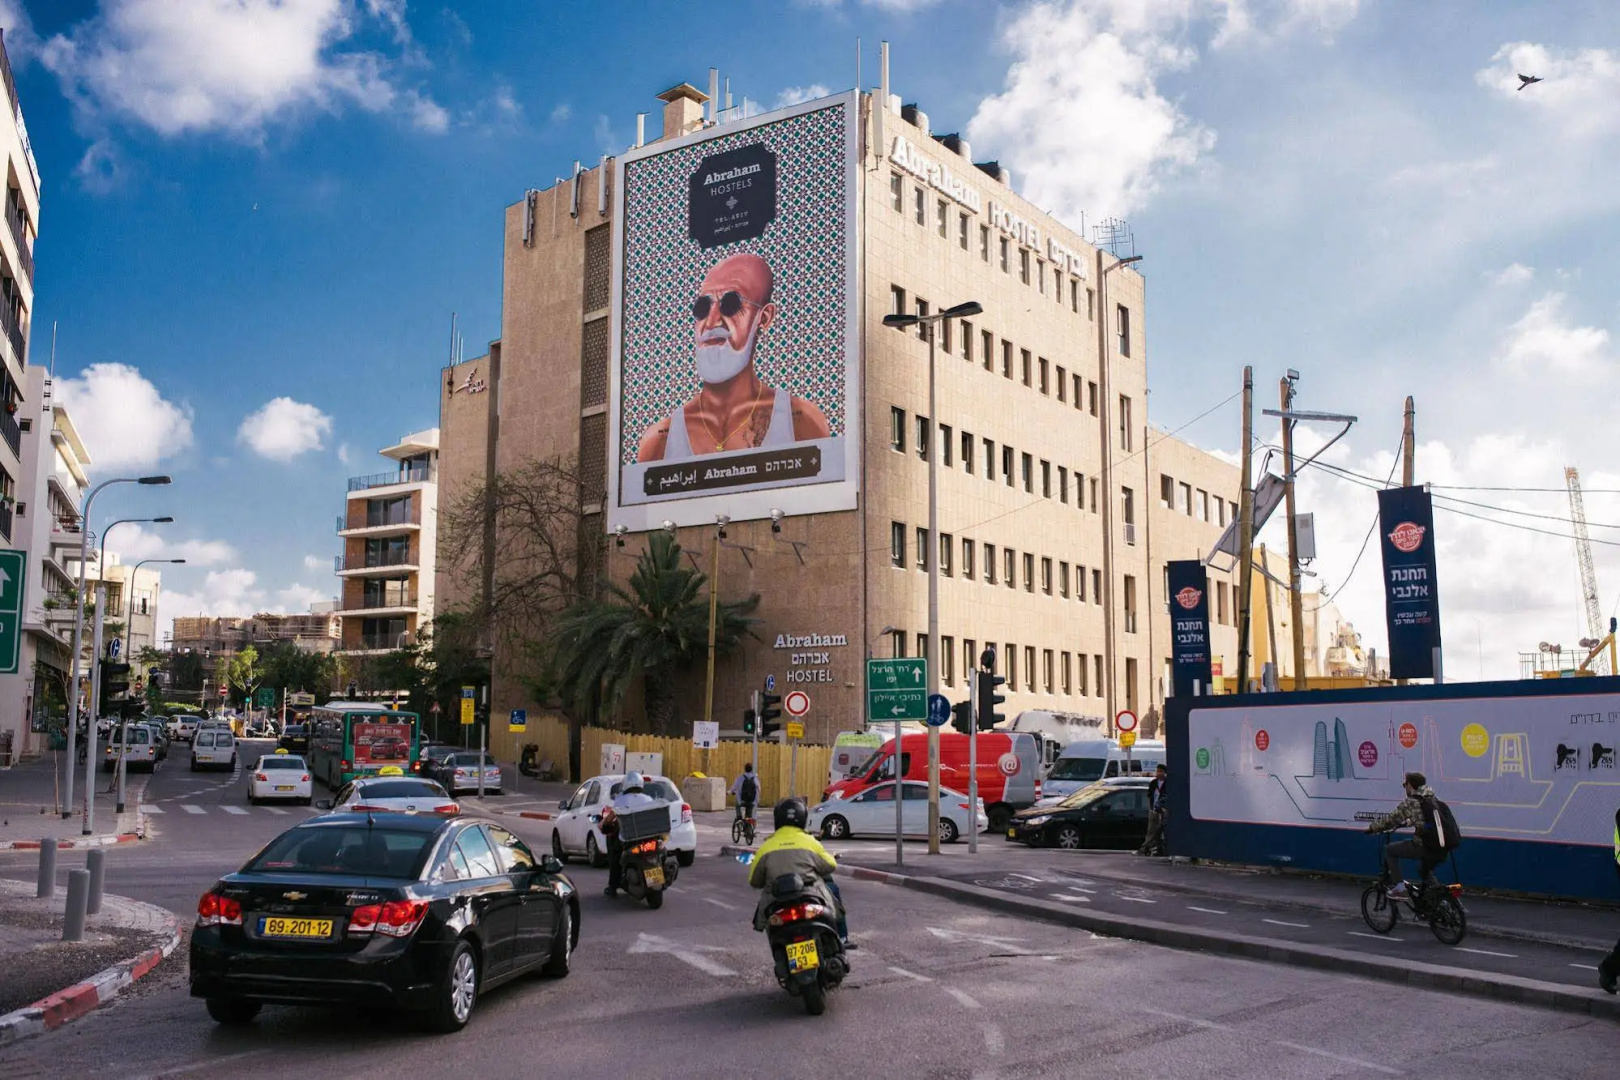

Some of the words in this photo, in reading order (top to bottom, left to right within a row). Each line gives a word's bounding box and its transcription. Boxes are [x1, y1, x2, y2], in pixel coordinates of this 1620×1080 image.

[703, 163, 761, 186] Abraham
[710, 178, 753, 196] HOSTELS
[889, 135, 981, 214] Abraham
[988, 200, 1042, 254] HOSTEL
[703, 464, 758, 480] Abraham
[765, 458, 803, 472] אברהם
[1391, 568, 1427, 581] תחנת
[1392, 584, 1429, 598] אלנבי
[1177, 621, 1203, 631] תחנת
[773, 632, 848, 649] Abraham
[1177, 633, 1204, 643] אלנבי
[791, 652, 830, 665] אברהם
[786, 669, 834, 683] HOSTEL
